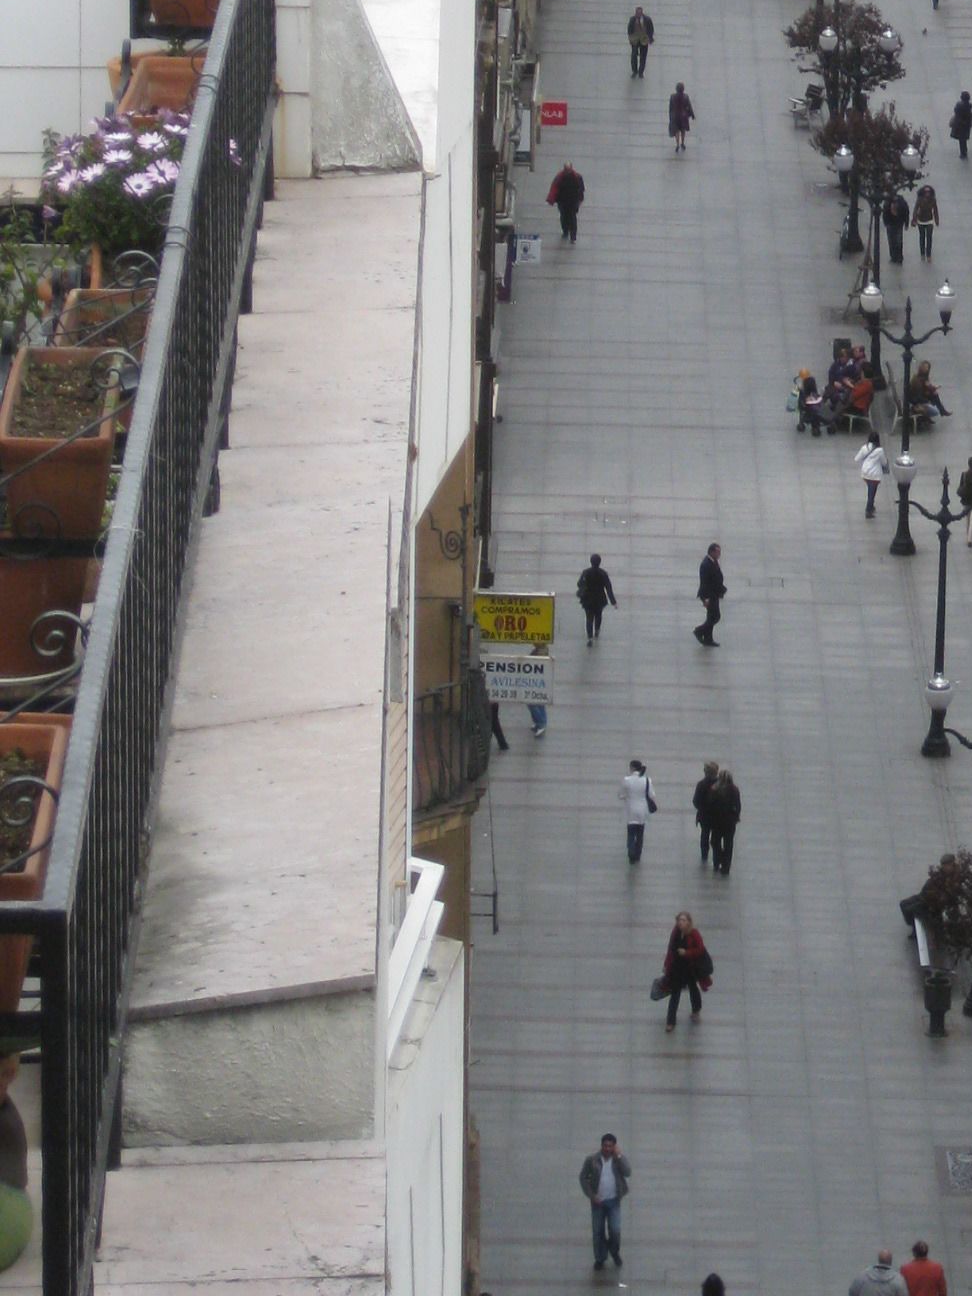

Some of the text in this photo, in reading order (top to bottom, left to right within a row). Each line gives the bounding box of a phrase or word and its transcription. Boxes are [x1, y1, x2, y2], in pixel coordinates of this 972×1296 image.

[480, 606, 541, 616] COMPRAMOS
[494, 615, 528, 633] ORO
[490, 676, 546, 689] AVILESINA
